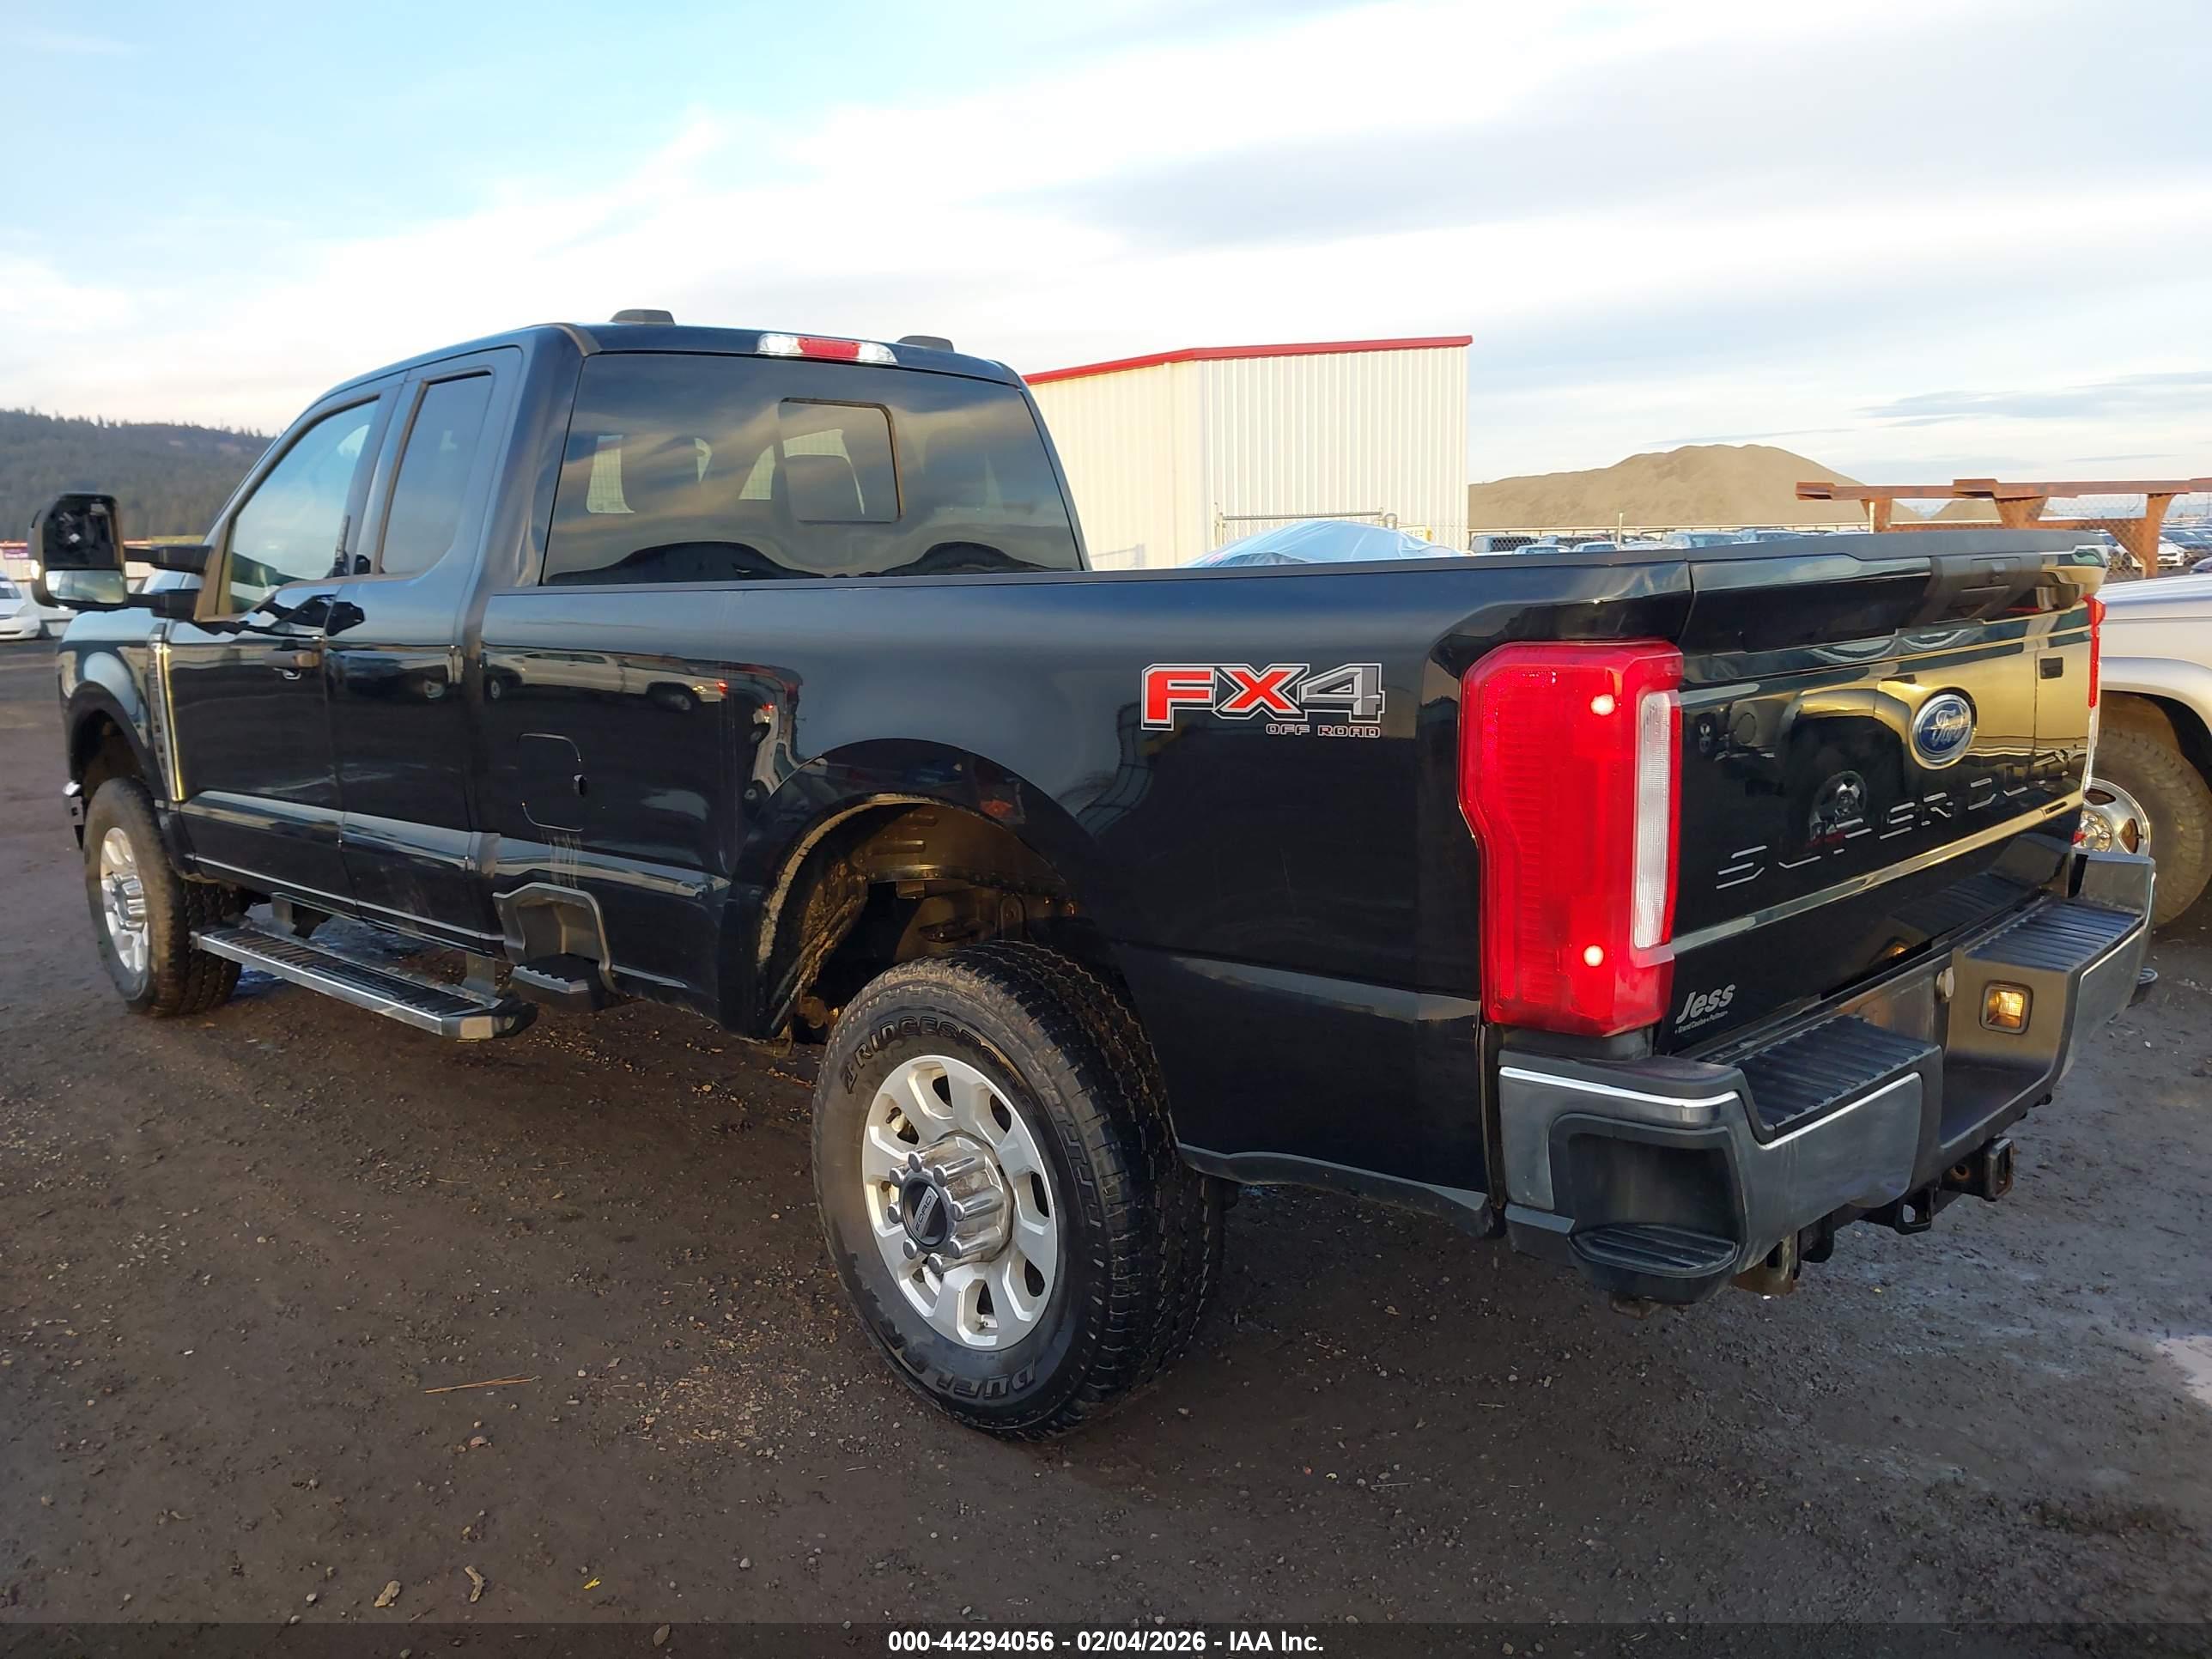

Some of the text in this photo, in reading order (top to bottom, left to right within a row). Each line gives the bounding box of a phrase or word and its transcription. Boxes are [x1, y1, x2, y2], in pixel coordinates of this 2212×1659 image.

[1141, 663, 1385, 731] FX4
[1265, 723, 1381, 738] OFF ROAD
[1923, 707, 1966, 748] Ford
[1675, 983, 1735, 1024] Jess
[915, 1194, 933, 1231] FORD
